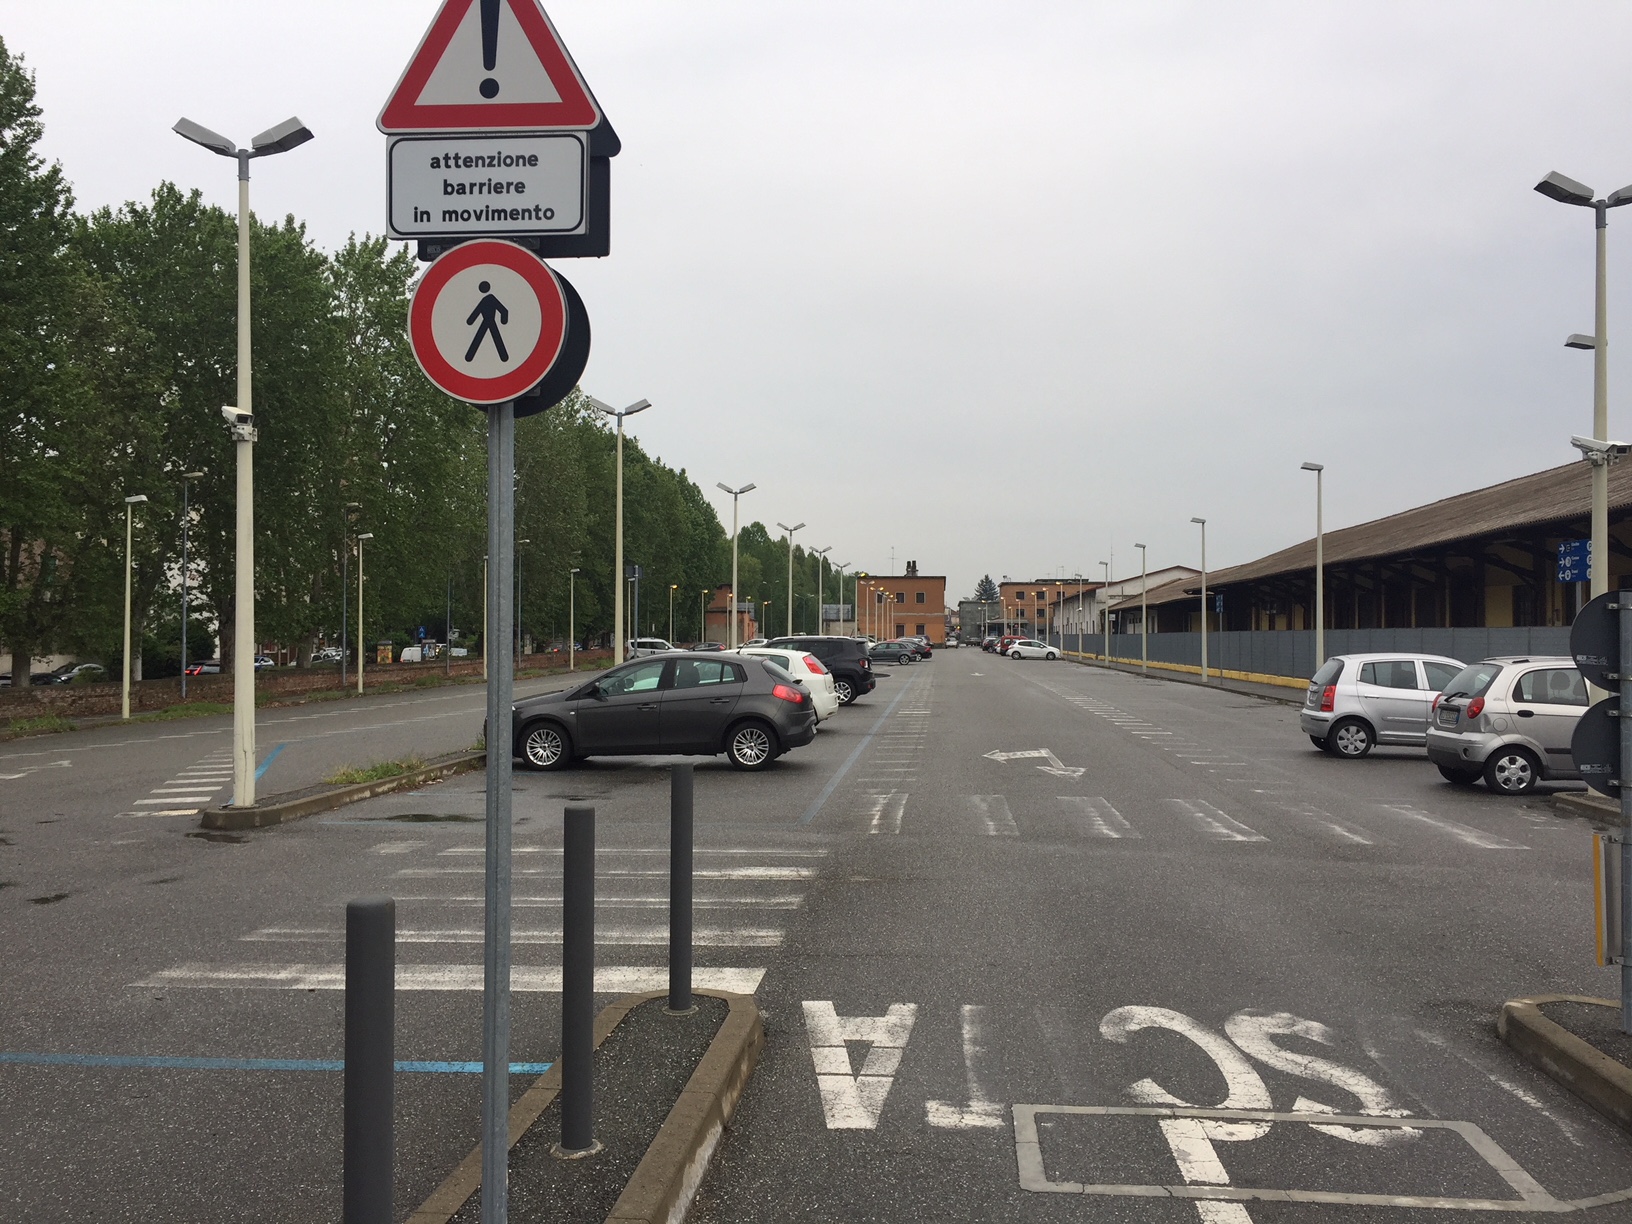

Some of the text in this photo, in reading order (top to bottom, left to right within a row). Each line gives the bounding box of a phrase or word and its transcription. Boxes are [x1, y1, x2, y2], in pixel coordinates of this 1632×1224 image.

[430, 151, 539, 169] attenzione
[443, 178, 526, 195] barriere
[413, 204, 555, 223] in movimento
